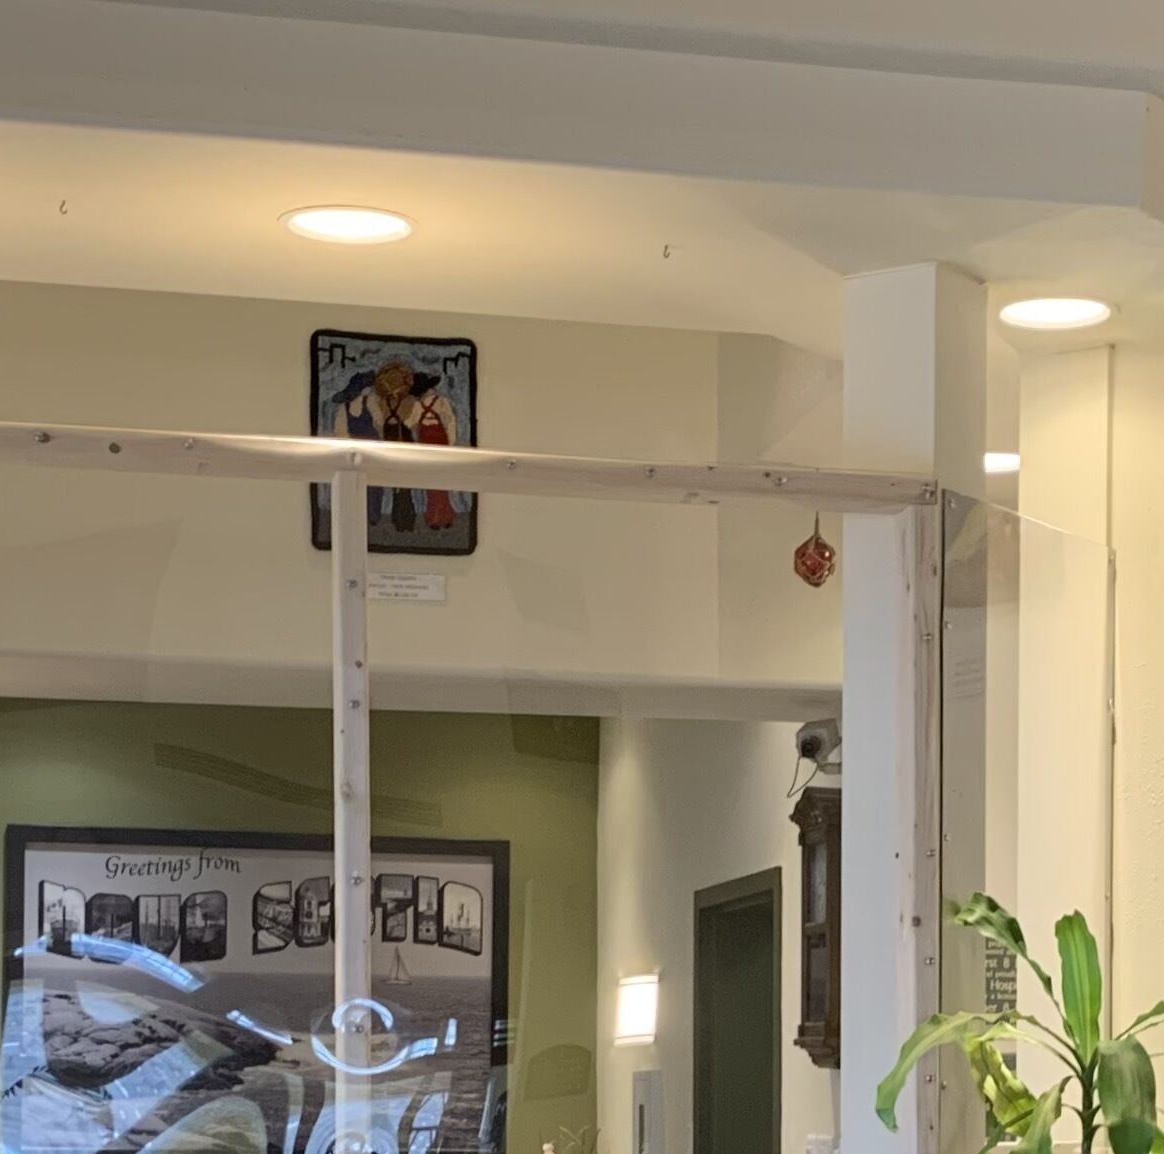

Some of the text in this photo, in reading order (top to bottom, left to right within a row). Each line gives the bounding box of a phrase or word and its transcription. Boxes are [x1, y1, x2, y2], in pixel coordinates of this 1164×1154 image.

[104, 847, 242, 883] Greetings from
[252, 872, 484, 956] SCTIA
